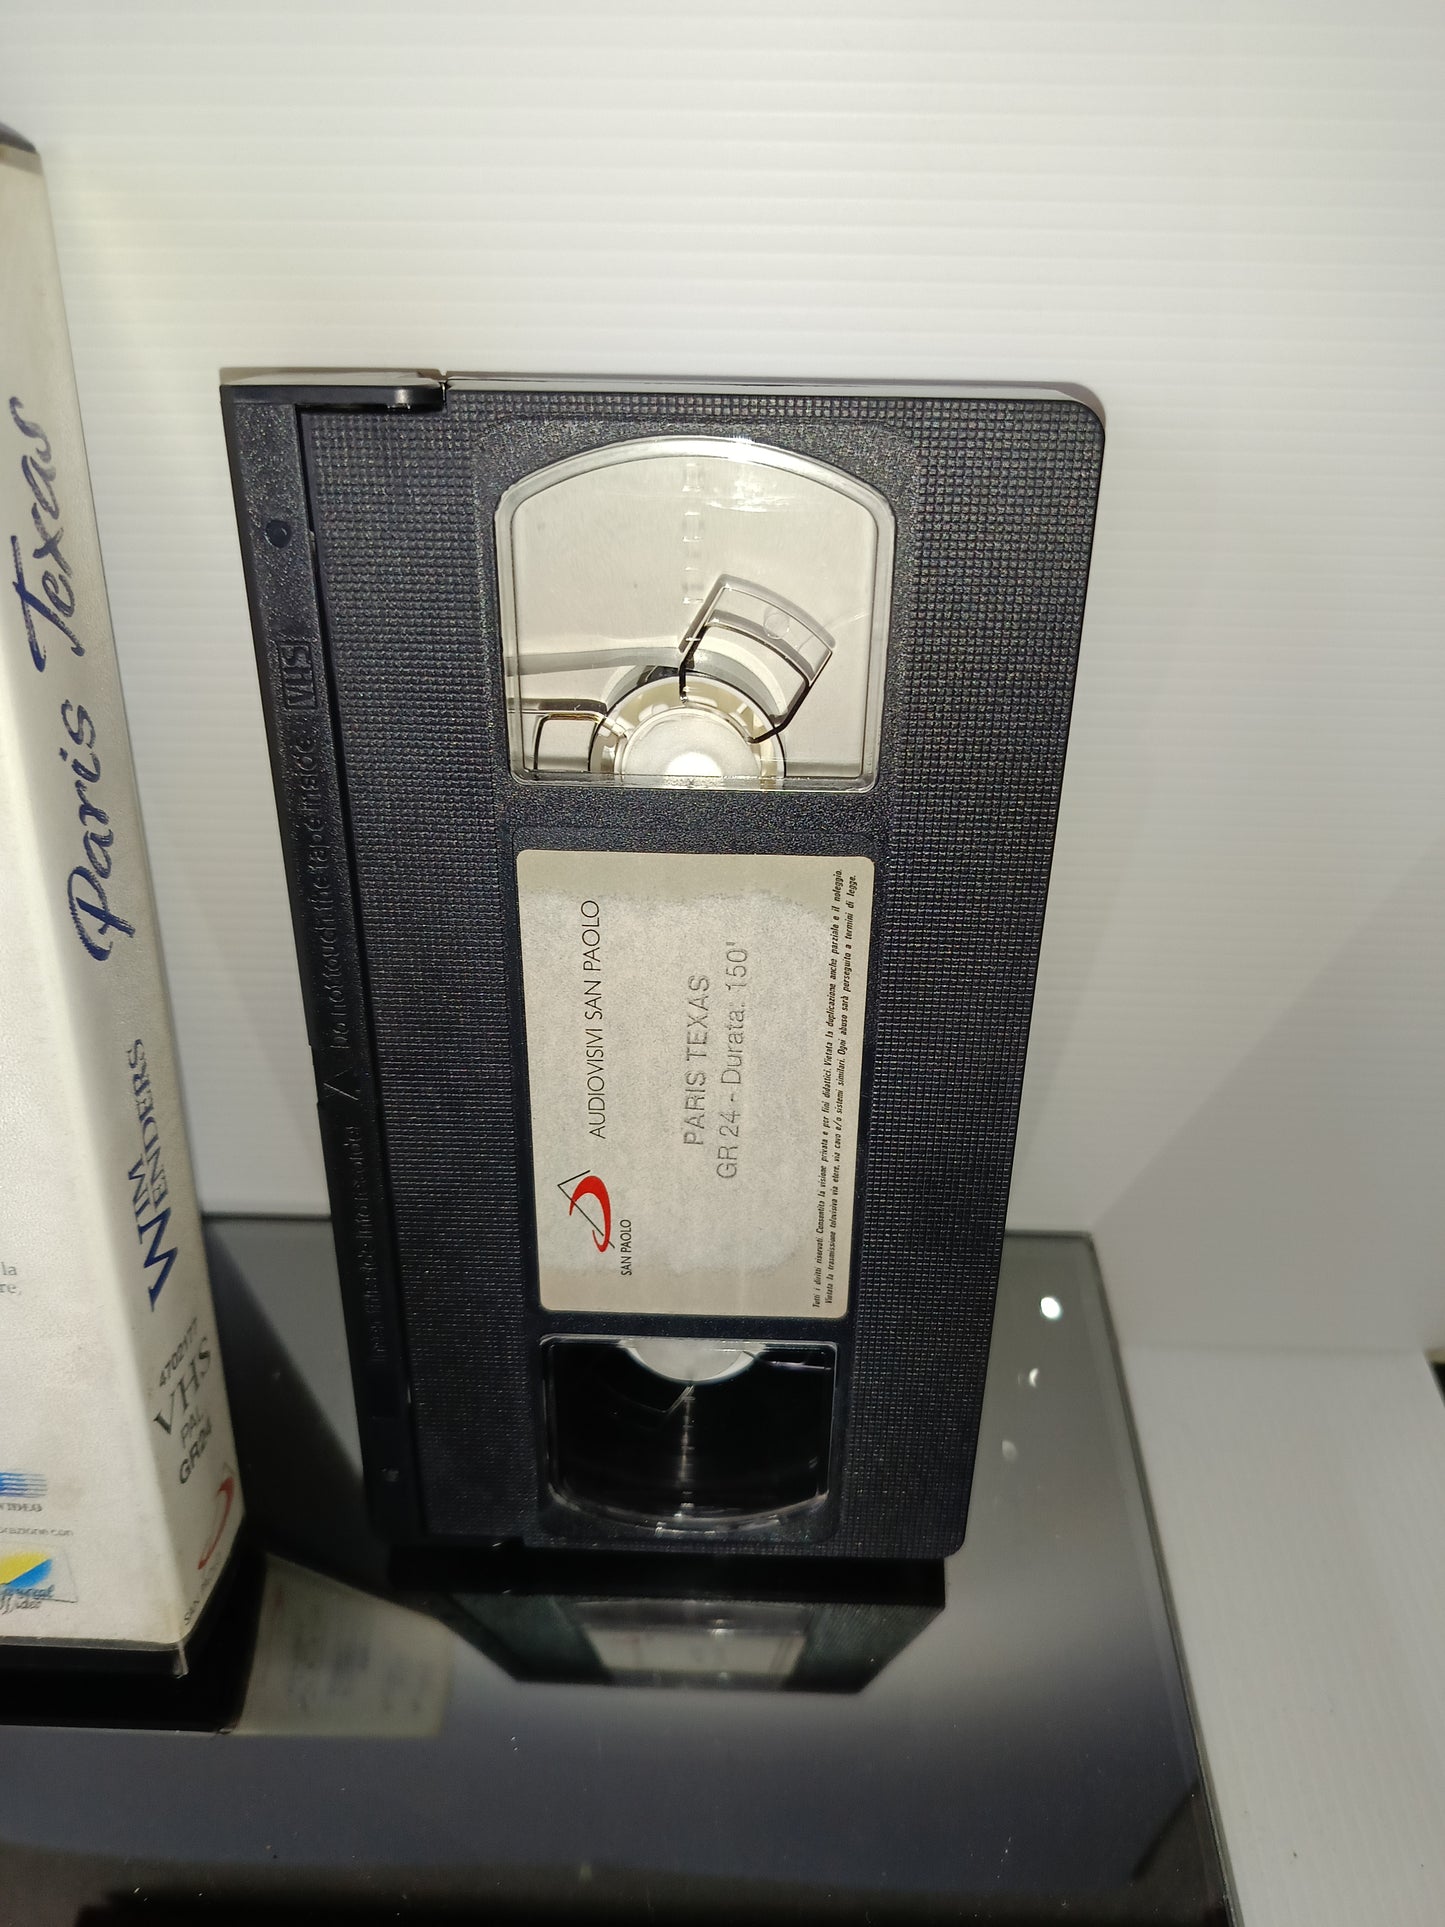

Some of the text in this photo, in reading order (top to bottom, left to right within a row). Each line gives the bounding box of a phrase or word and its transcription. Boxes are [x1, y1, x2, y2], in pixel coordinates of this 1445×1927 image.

[9, 395, 136, 962] Paris Texas
[281, 644, 317, 707] VHS
[845, 875, 858, 896] legge.
[829, 921, 841, 954] parziale
[843, 912, 854, 939] termini
[827, 958, 838, 980] anche
[841, 953, 853, 992] perseguito
[825, 984, 837, 1027] duplicazione
[581, 900, 606, 1139] AUDIOVISIVI SAN PAOLO
[837, 1014, 849, 1035] abuso
[823, 1042, 833, 1066] Vietata
[836, 1038, 849, 1055] Ogni
[683, 974, 710, 1145] PARIS TEXAS
[833, 1089, 844, 1114] sistemi
[719, 1110, 741, 1138] 24
[822, 1116, 831, 1128] per
[832, 1117, 843, 1130] e/o
[819, 1139, 830, 1162] privata
[833, 1134, 842, 1148] cavo
[716, 1145, 738, 1180] GR
[831, 1152, 841, 1162] via
[817, 1166, 827, 1187] visione
[829, 1186, 839, 1195] via
[815, 1201, 826, 1234] Consentita
[619, 1218, 632, 1276] SAN PAOLO
[827, 1231, 837, 1270] trasmissione
[1, 1261, 17, 1276] la
[813, 1267, 822, 1285] diritti
[811, 1294, 821, 1308] Tutti
[824, 1284, 834, 1303] Vietata
[153, 1335, 211, 1436] VHS
